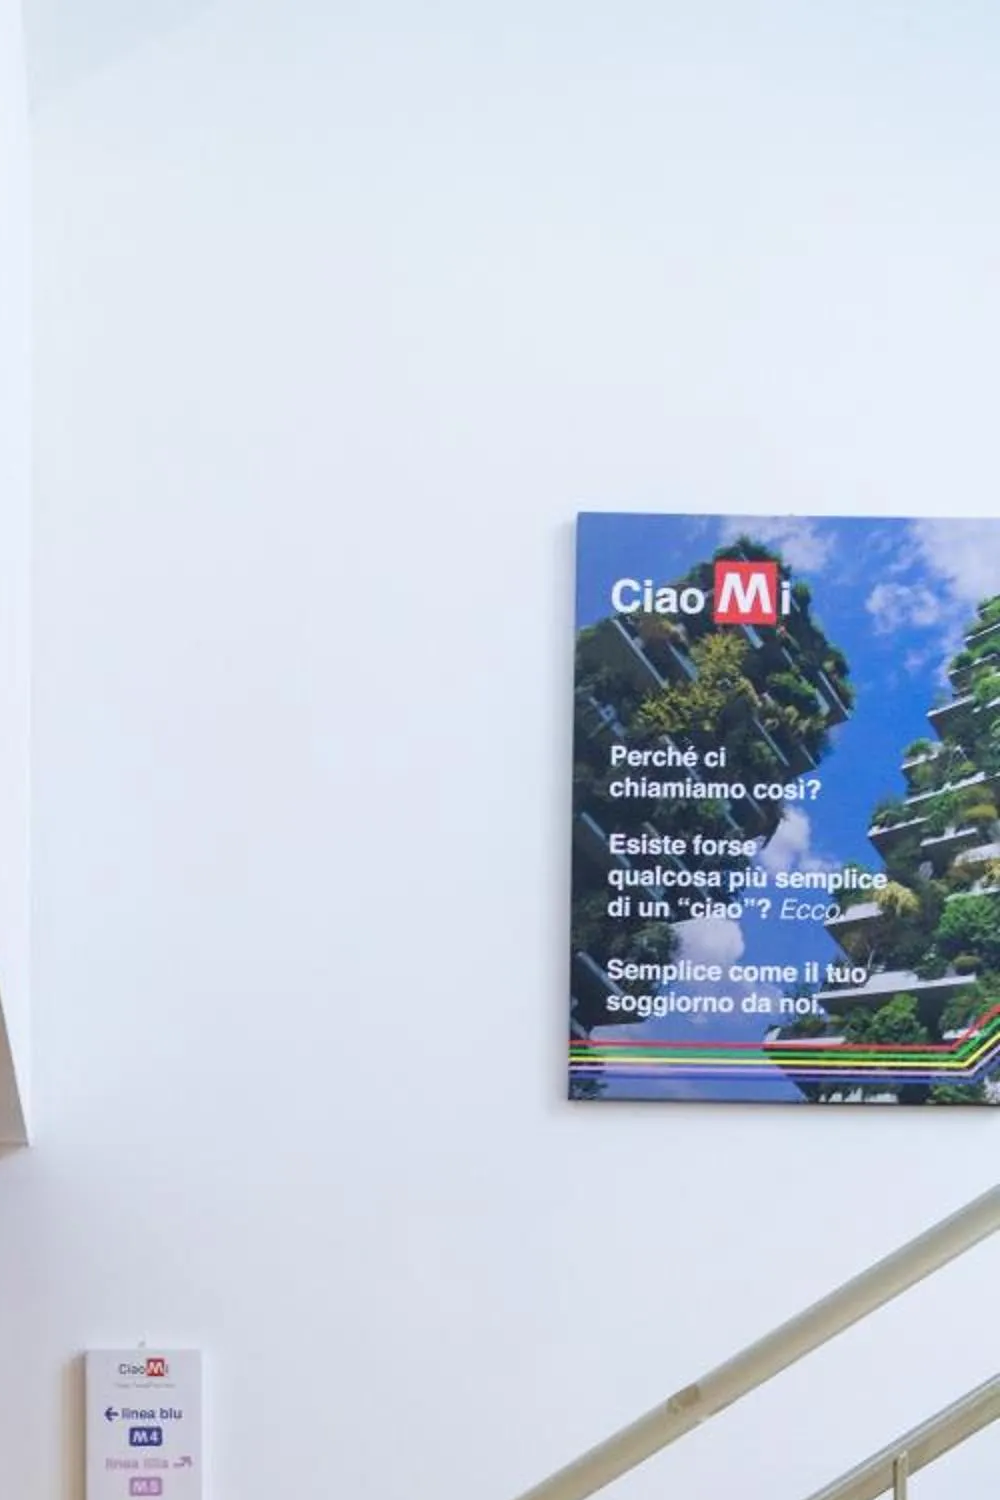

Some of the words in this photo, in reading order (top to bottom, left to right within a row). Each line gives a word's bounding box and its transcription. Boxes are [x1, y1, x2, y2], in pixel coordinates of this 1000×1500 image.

[611, 746, 698, 767] Perché
[704, 747, 726, 767] ci
[609, 776, 746, 799] chiamiamo
[753, 778, 822, 800] così?
[609, 834, 687, 855] Esiste
[692, 834, 757, 856] forse
[608, 866, 721, 889] qualcosa
[729, 867, 767, 891] più
[775, 868, 888, 894] semplice
[607, 896, 631, 917] di
[638, 901, 670, 917] un
[779, 899, 845, 921] Ecco.
[607, 959, 722, 987] Semplice
[728, 966, 798, 983] come
[804, 962, 818, 982] il
[827, 964, 866, 983] tuo
[606, 991, 734, 1016] soggiorno
[741, 994, 771, 1013] da
[779, 996, 825, 1014] noi.
[121, 1408, 155, 1420] linea
[160, 1407, 182, 1420] blu
[132, 1431, 160, 1442] M4
